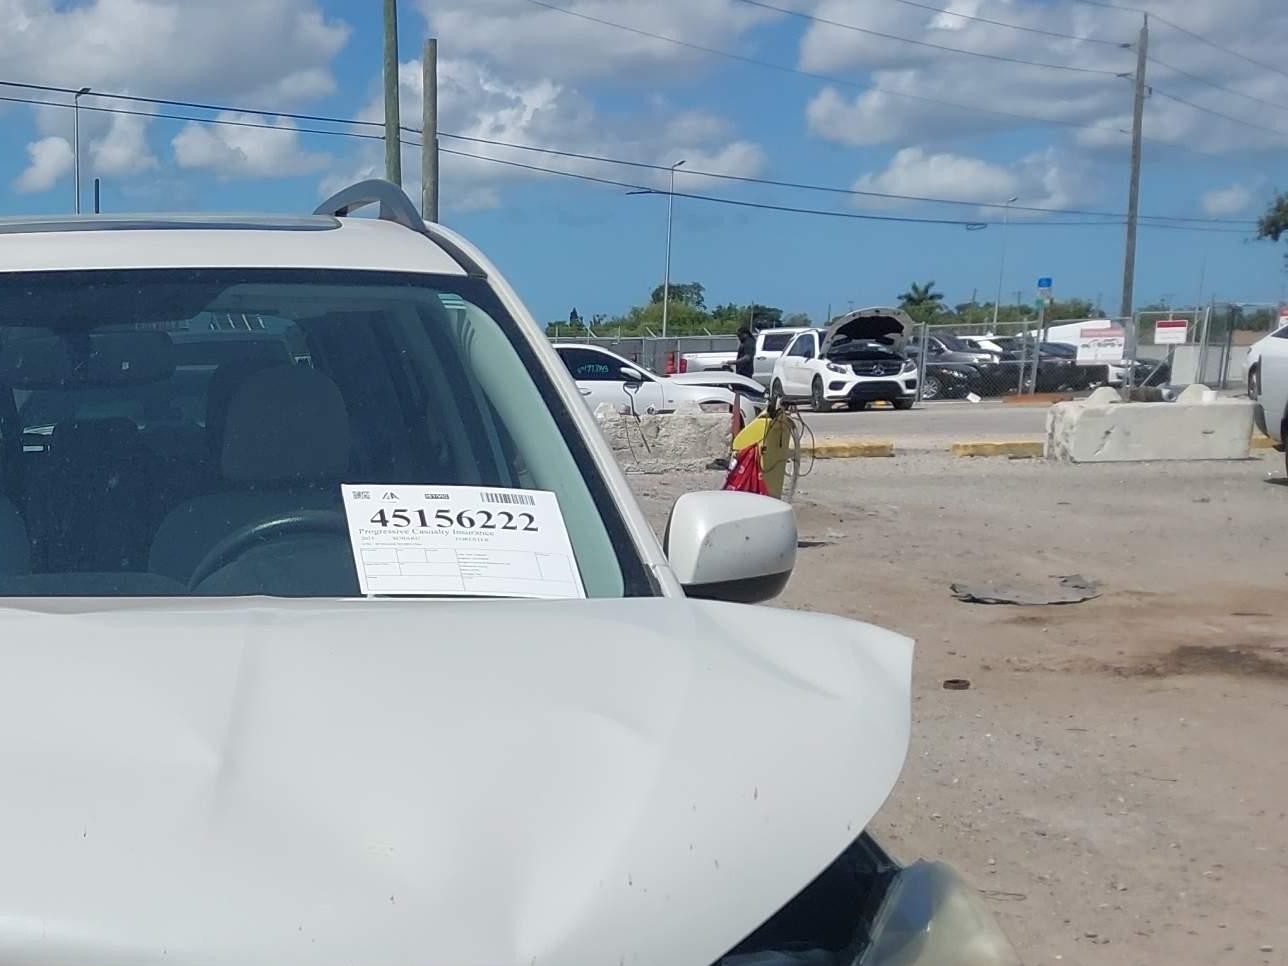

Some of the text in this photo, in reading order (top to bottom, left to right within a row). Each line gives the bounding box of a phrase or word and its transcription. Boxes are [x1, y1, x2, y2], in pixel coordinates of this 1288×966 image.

[370, 508, 539, 532] 45156222
[358, 528, 495, 537] Progressive Casualty Insurance
